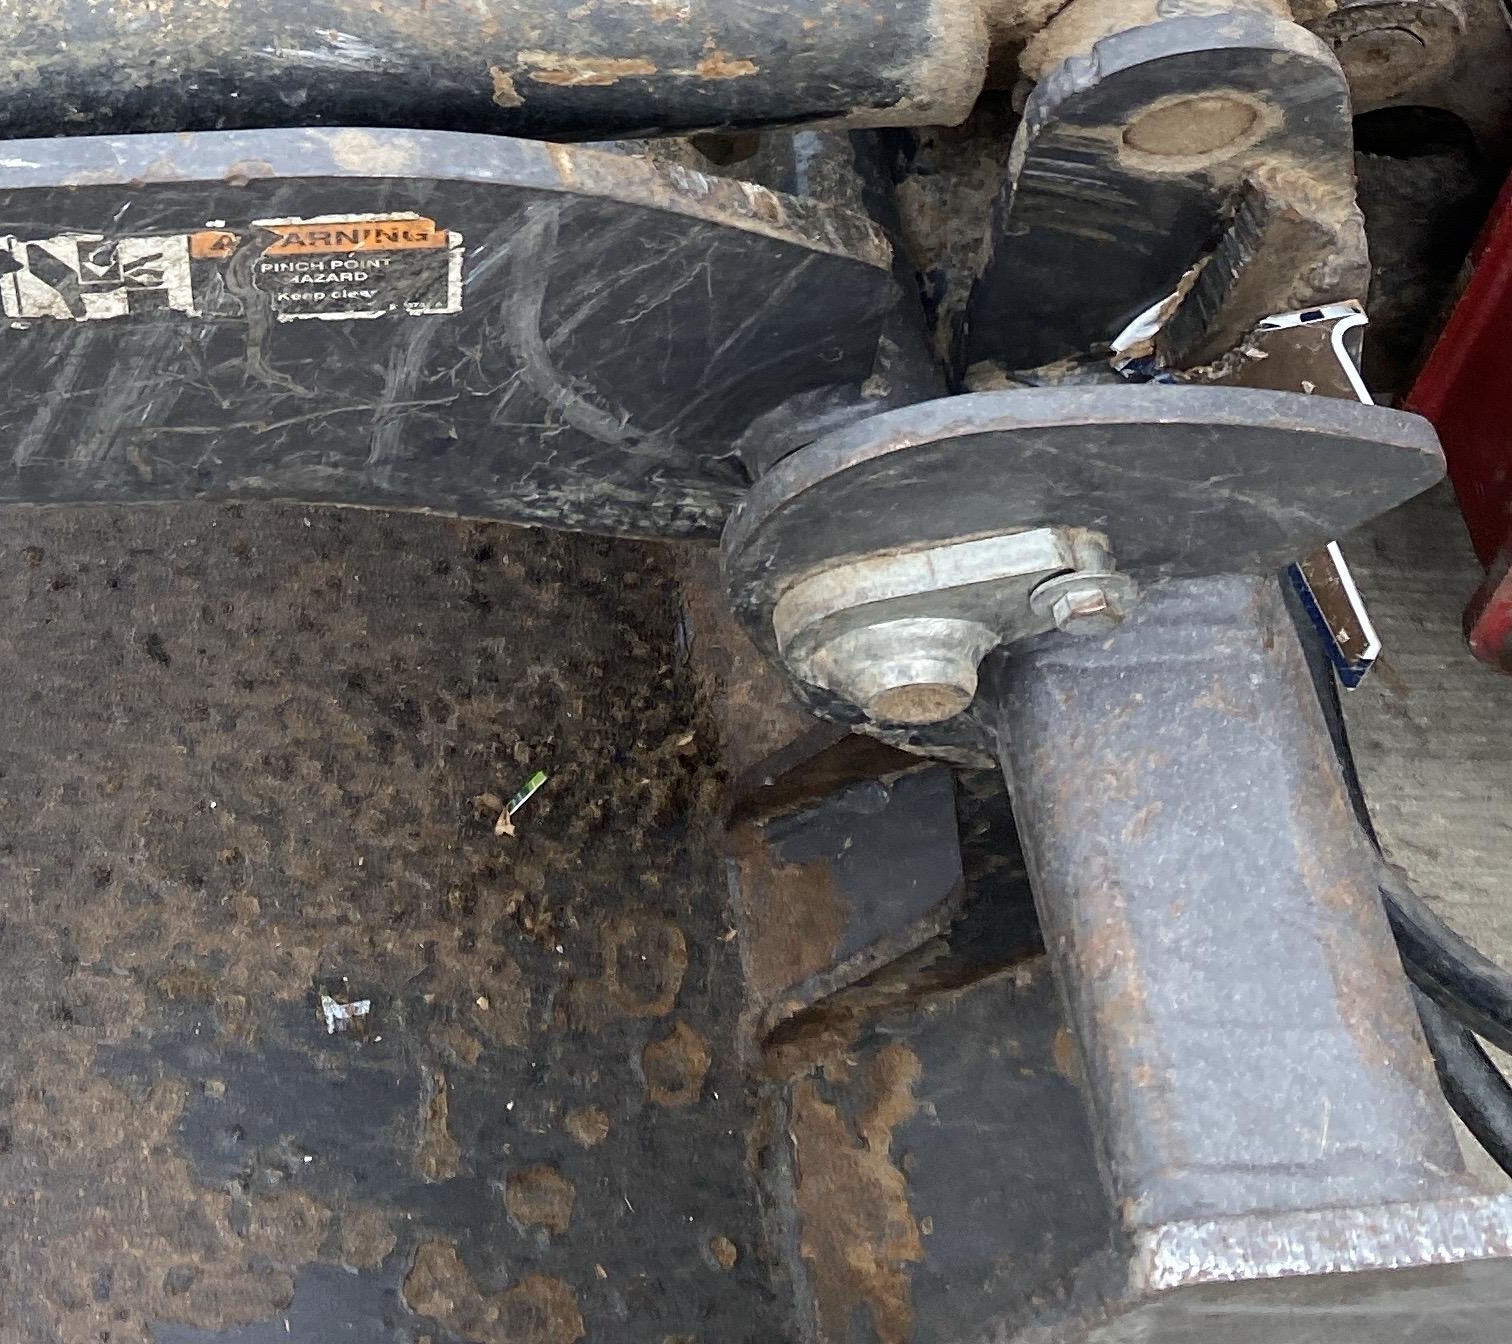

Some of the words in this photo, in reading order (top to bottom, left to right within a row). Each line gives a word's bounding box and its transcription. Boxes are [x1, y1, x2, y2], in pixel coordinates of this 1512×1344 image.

[280, 227, 429, 248] ARNING
[260, 259, 325, 273] PINCH
[330, 256, 392, 272] POINT
